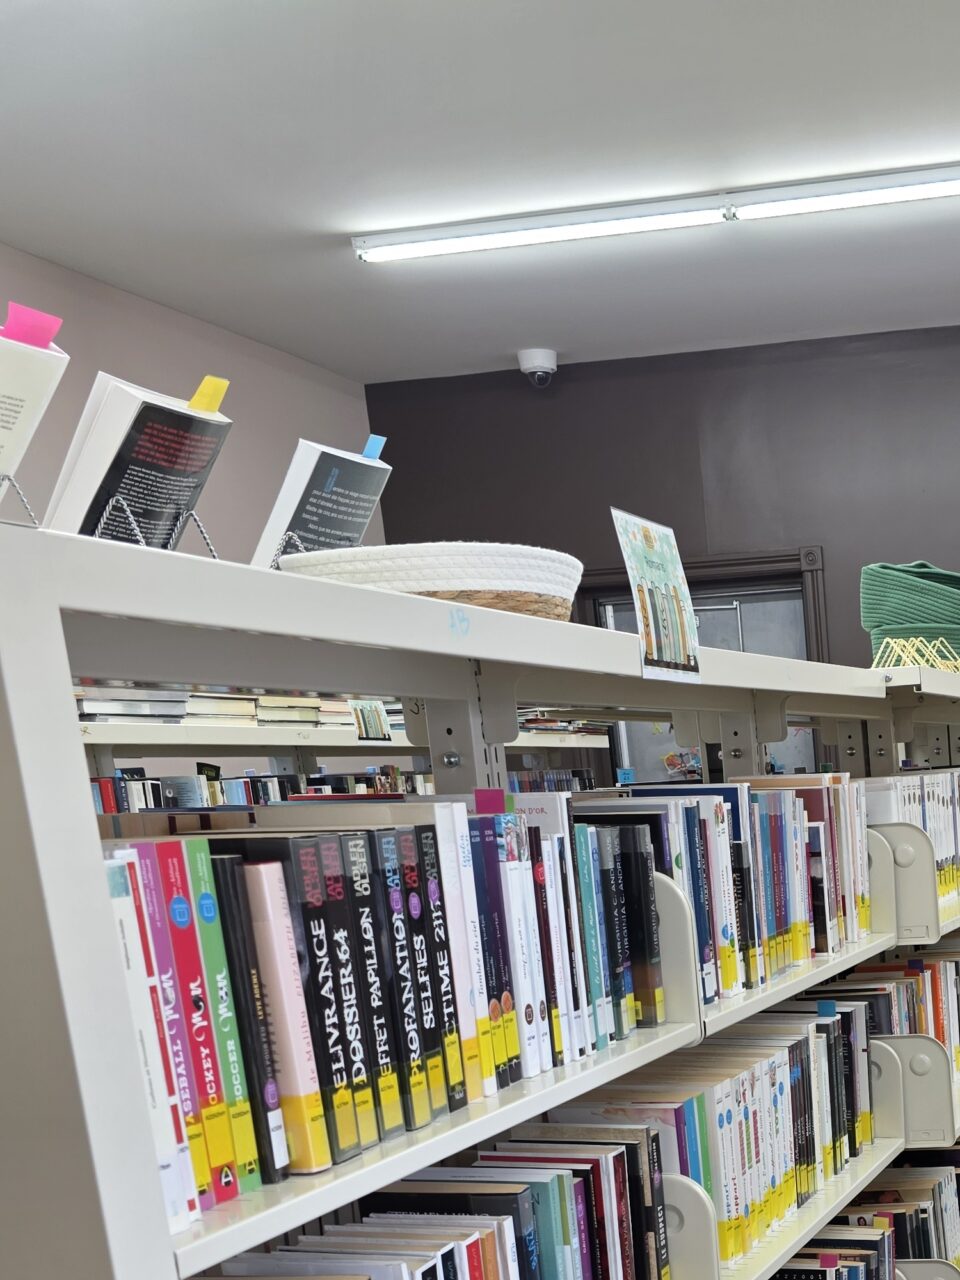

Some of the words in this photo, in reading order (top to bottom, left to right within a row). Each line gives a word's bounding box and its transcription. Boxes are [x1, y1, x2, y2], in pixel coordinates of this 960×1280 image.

[333, 928, 351, 963] 64
[359, 907, 384, 1009] PAPILLON
[413, 934, 436, 1030] SELFIES
[311, 918, 347, 1091] ELIVRANCE
[173, 1040, 195, 1124] ASEBALL
[200, 1046, 218, 1105] OCKEY
[656, 1205, 668, 1247] SUSPECT
